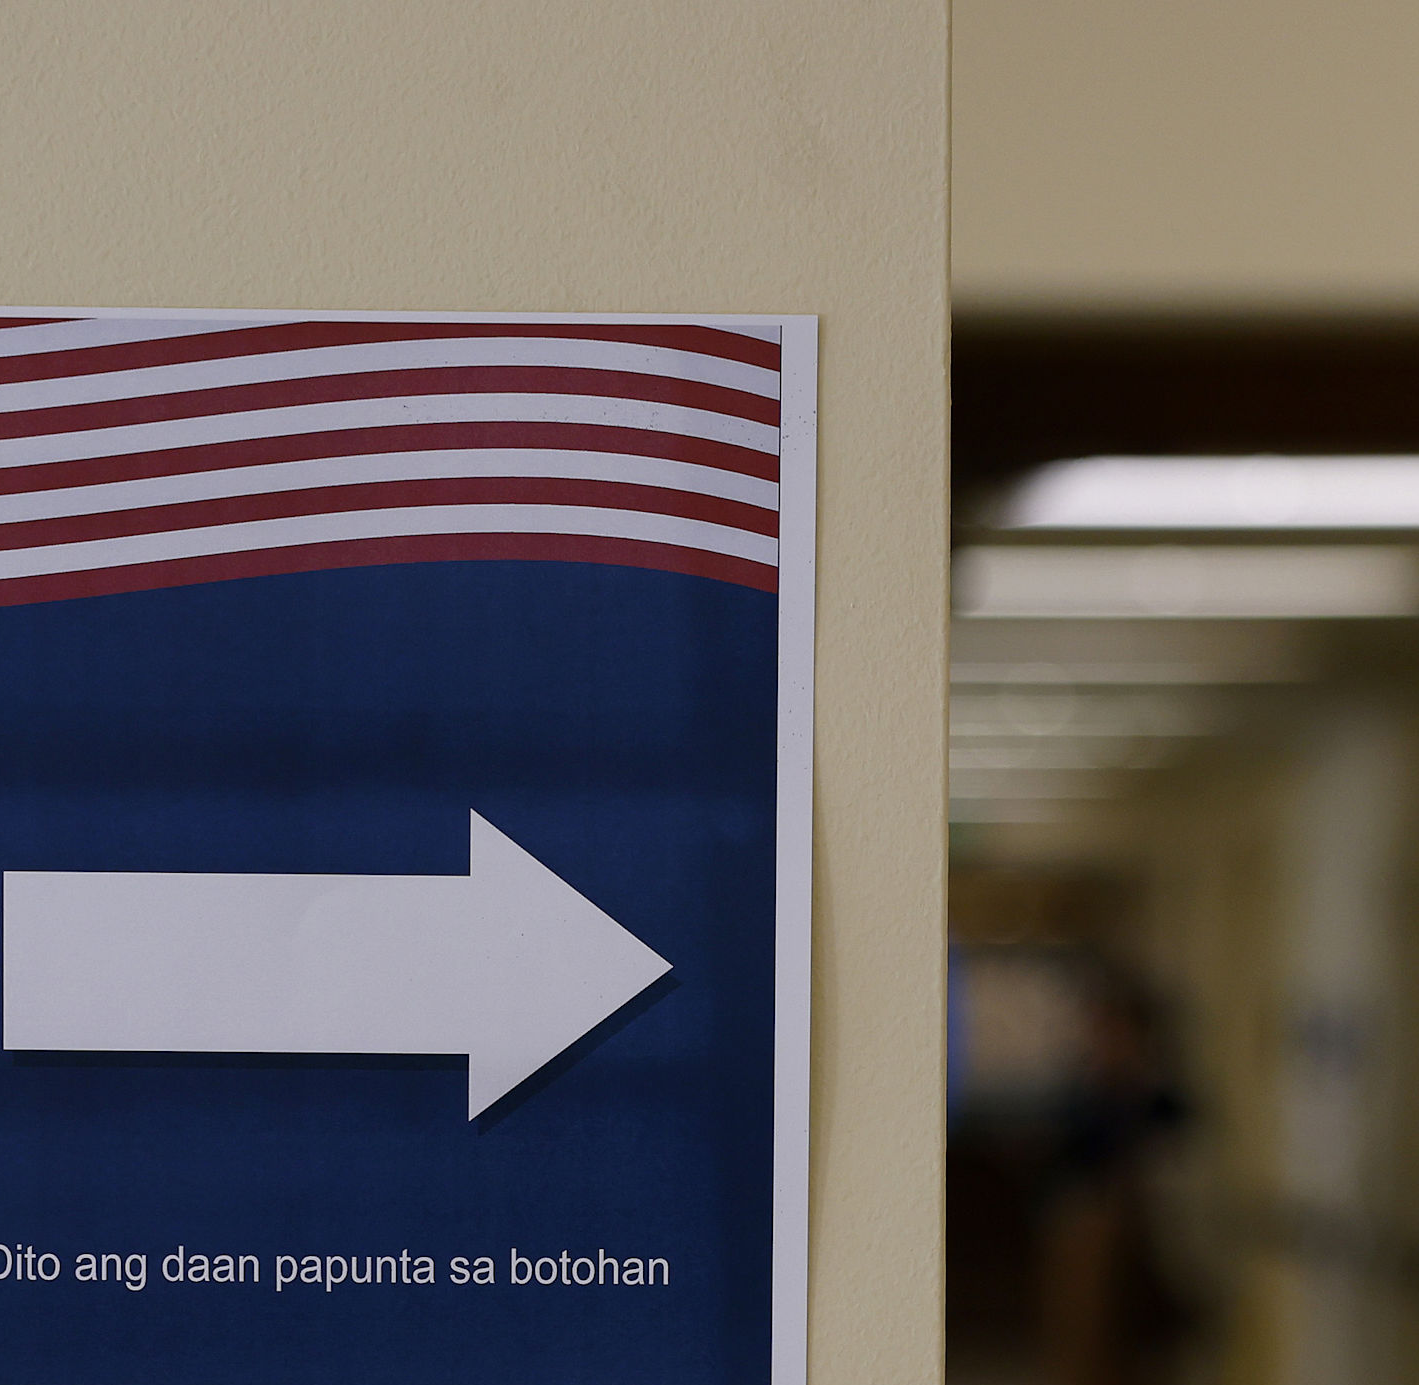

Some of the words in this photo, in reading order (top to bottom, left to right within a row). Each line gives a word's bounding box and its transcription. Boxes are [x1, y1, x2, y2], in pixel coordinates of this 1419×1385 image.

[74, 1253, 147, 1292] ang
[162, 1245, 260, 1283] daan
[275, 1248, 436, 1293] papunta
[449, 1256, 496, 1285] sa
[510, 1247, 669, 1286] botohan
